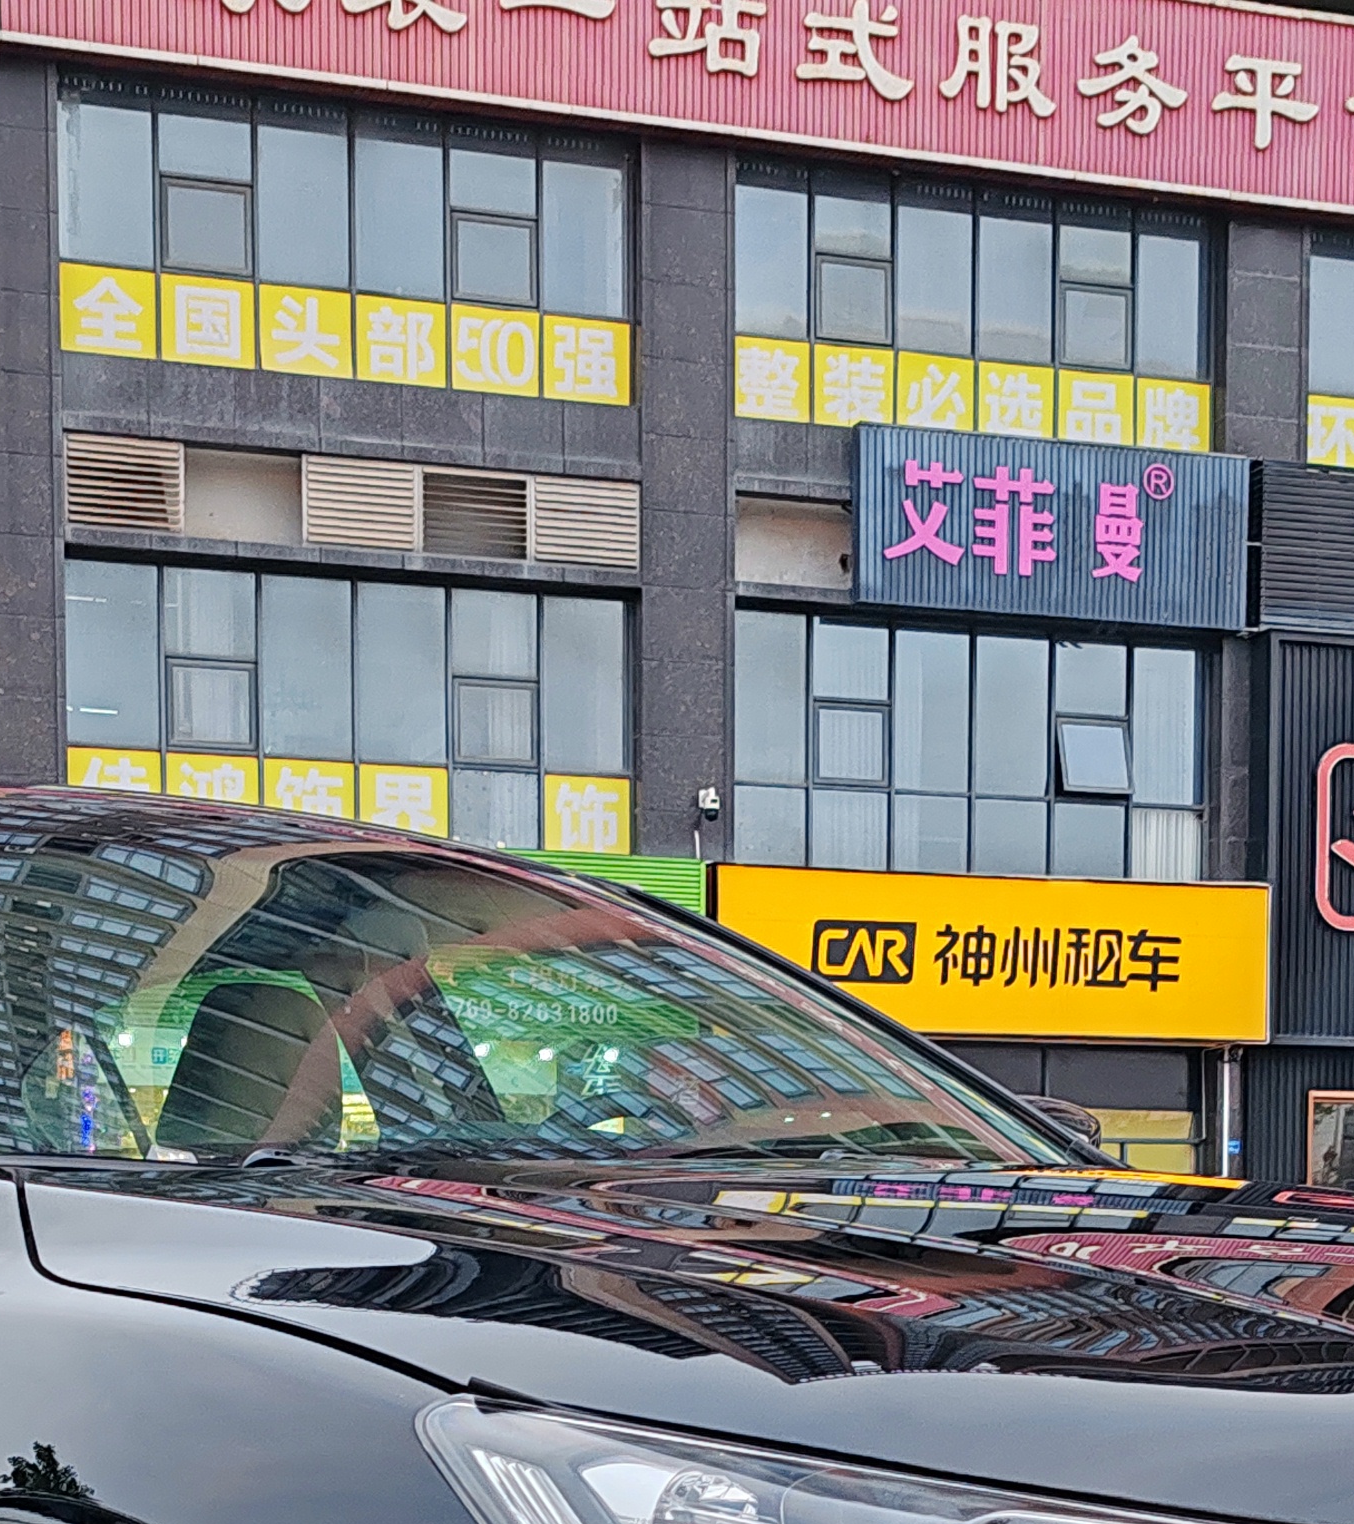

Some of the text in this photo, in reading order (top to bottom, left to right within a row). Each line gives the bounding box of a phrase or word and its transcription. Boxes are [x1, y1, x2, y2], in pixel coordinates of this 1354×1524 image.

[737, 345, 1199, 451] 整装必选品牌
[817, 923, 1182, 991] CAR 神州租车
